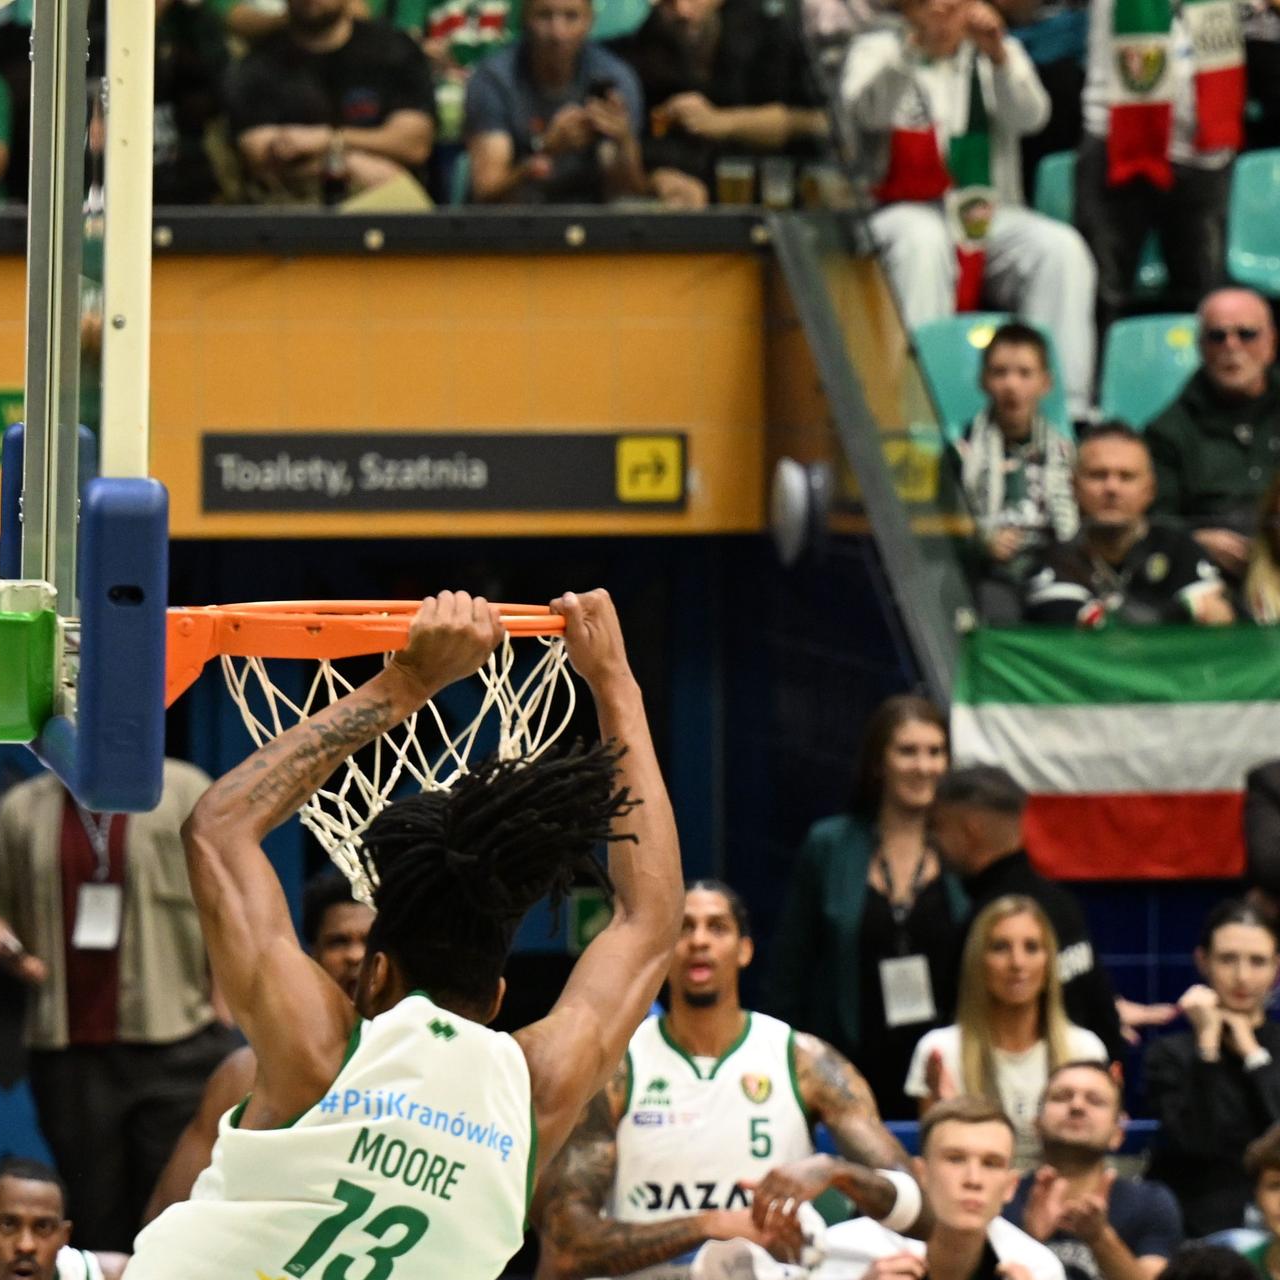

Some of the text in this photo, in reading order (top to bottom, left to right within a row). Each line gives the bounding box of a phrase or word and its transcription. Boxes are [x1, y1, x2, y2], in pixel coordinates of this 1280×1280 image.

[216, 452, 488, 497] Toalety, Szatnia
[320, 1089, 514, 1162] #PijKranówkę
[750, 1117, 772, 1158] 5
[348, 1127, 466, 1201] MOORE
[646, 1182, 751, 1210] BAZA
